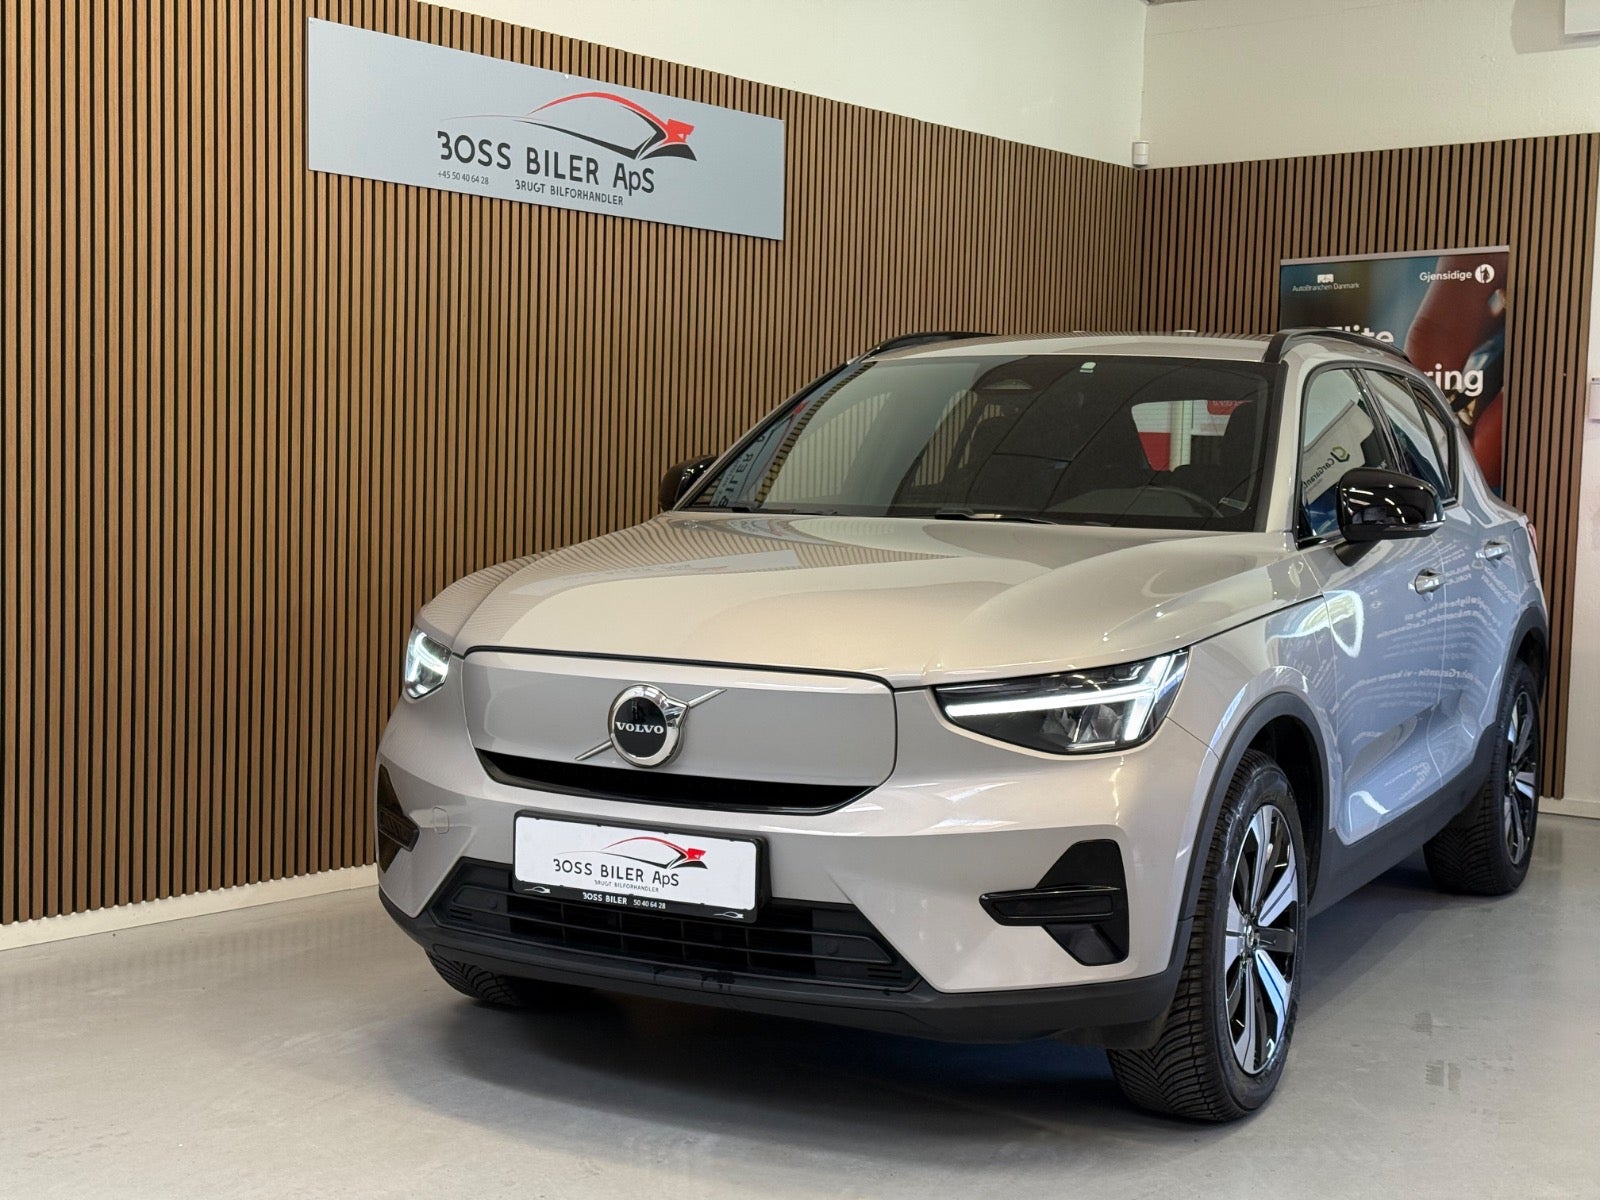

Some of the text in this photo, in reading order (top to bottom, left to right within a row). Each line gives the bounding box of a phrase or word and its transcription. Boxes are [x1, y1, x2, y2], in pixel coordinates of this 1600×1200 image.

[437, 170, 489, 185] +45 50 40 64 28
[526, 146, 599, 185] BILER
[612, 162, 655, 196] ApS
[550, 185, 624, 206] BILFORHANDLER
[1419, 270, 1473, 283] Gjensidige
[1292, 282, 1360, 292] AutoBranchen Danmark
[615, 721, 664, 735] VOLVO
[600, 864, 644, 882] BILER
[652, 870, 680, 888] ApS
[614, 881, 659, 893] BILFORHANDLER
[605, 894, 628, 905] BILER
[633, 899, 641, 907] 50
[641, 900, 650, 908] 40
[649, 901, 658, 909] 64
[658, 902, 666, 910] 28
